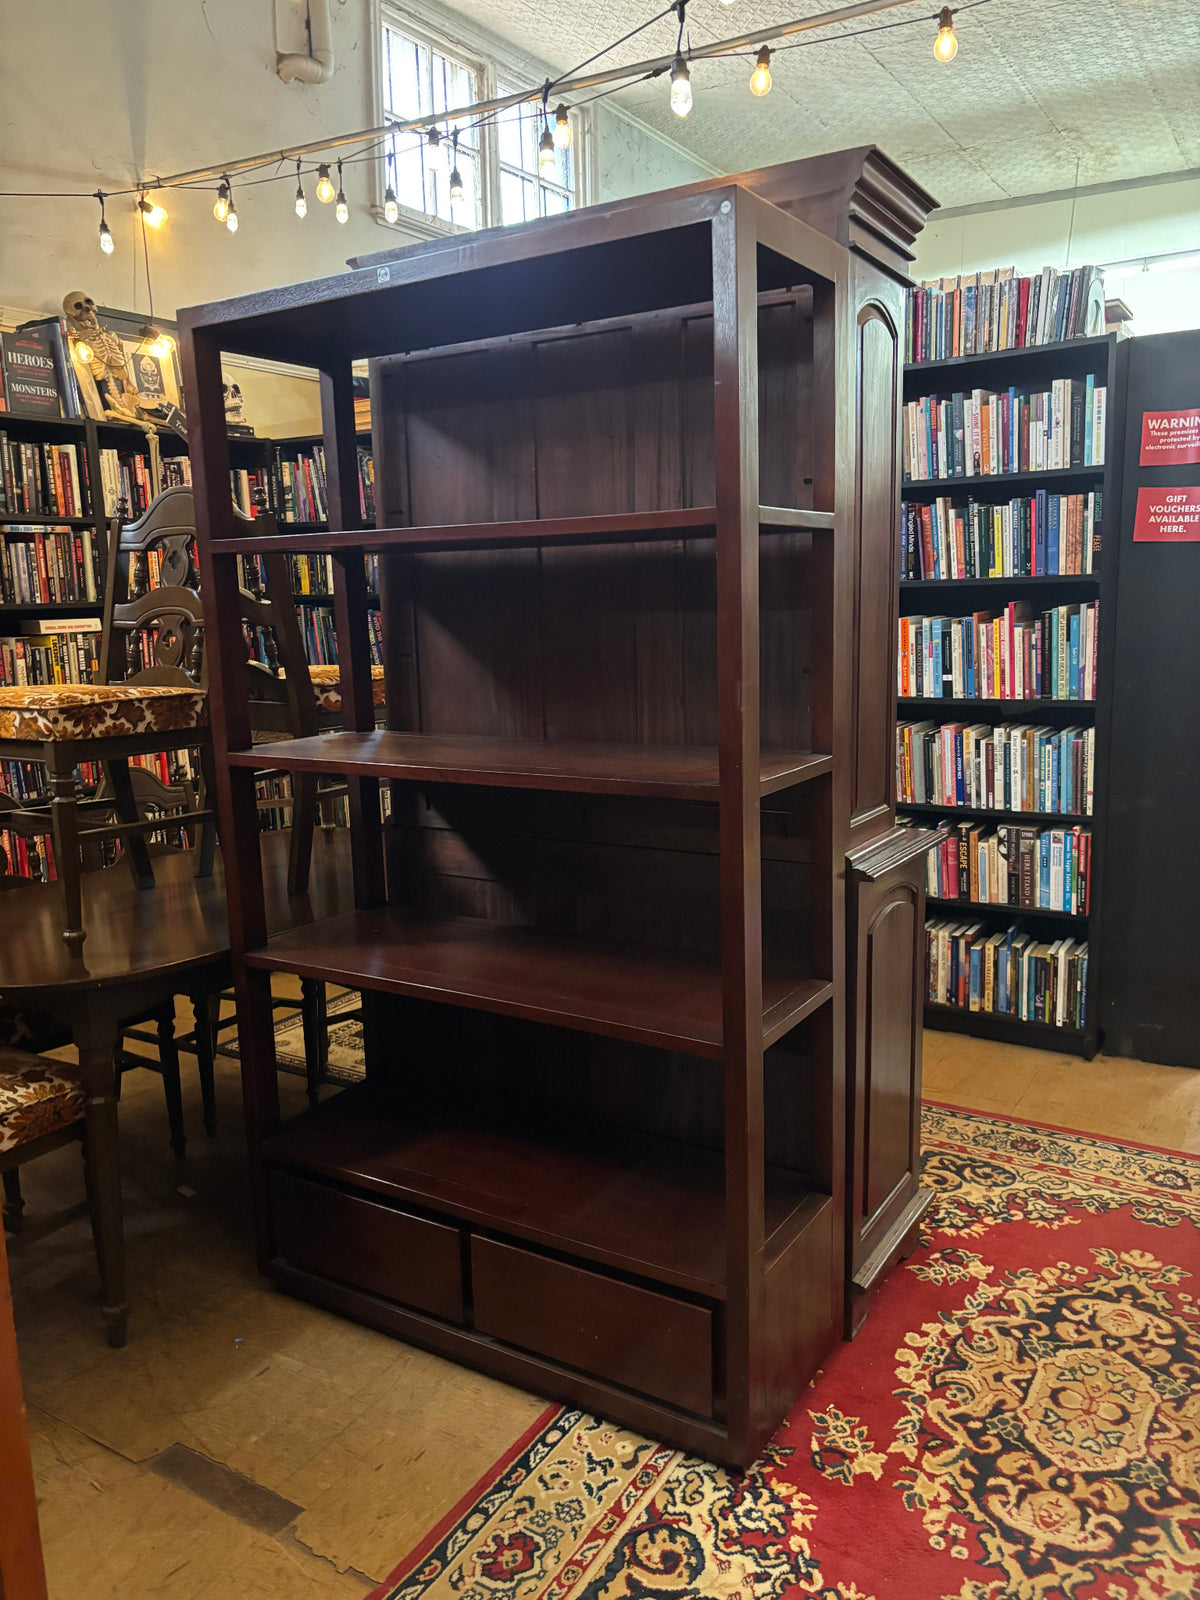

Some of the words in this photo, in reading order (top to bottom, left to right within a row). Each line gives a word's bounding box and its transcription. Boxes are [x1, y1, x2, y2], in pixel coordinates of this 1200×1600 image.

[8, 351, 54, 370] HEROES
[11, 383, 57, 397] MONSTERS
[1170, 428, 1199, 437] premises
[1160, 435, 1191, 444] protected
[1166, 495, 1187, 503] GIFT
[1149, 505, 1200, 513] VOUCHERS
[1149, 515, 1200, 523] AVAILABLE
[1160, 525, 1187, 533] HERE.
[1093, 535, 1101, 551] PEASE
[959, 842, 967, 869] ESCAPE
